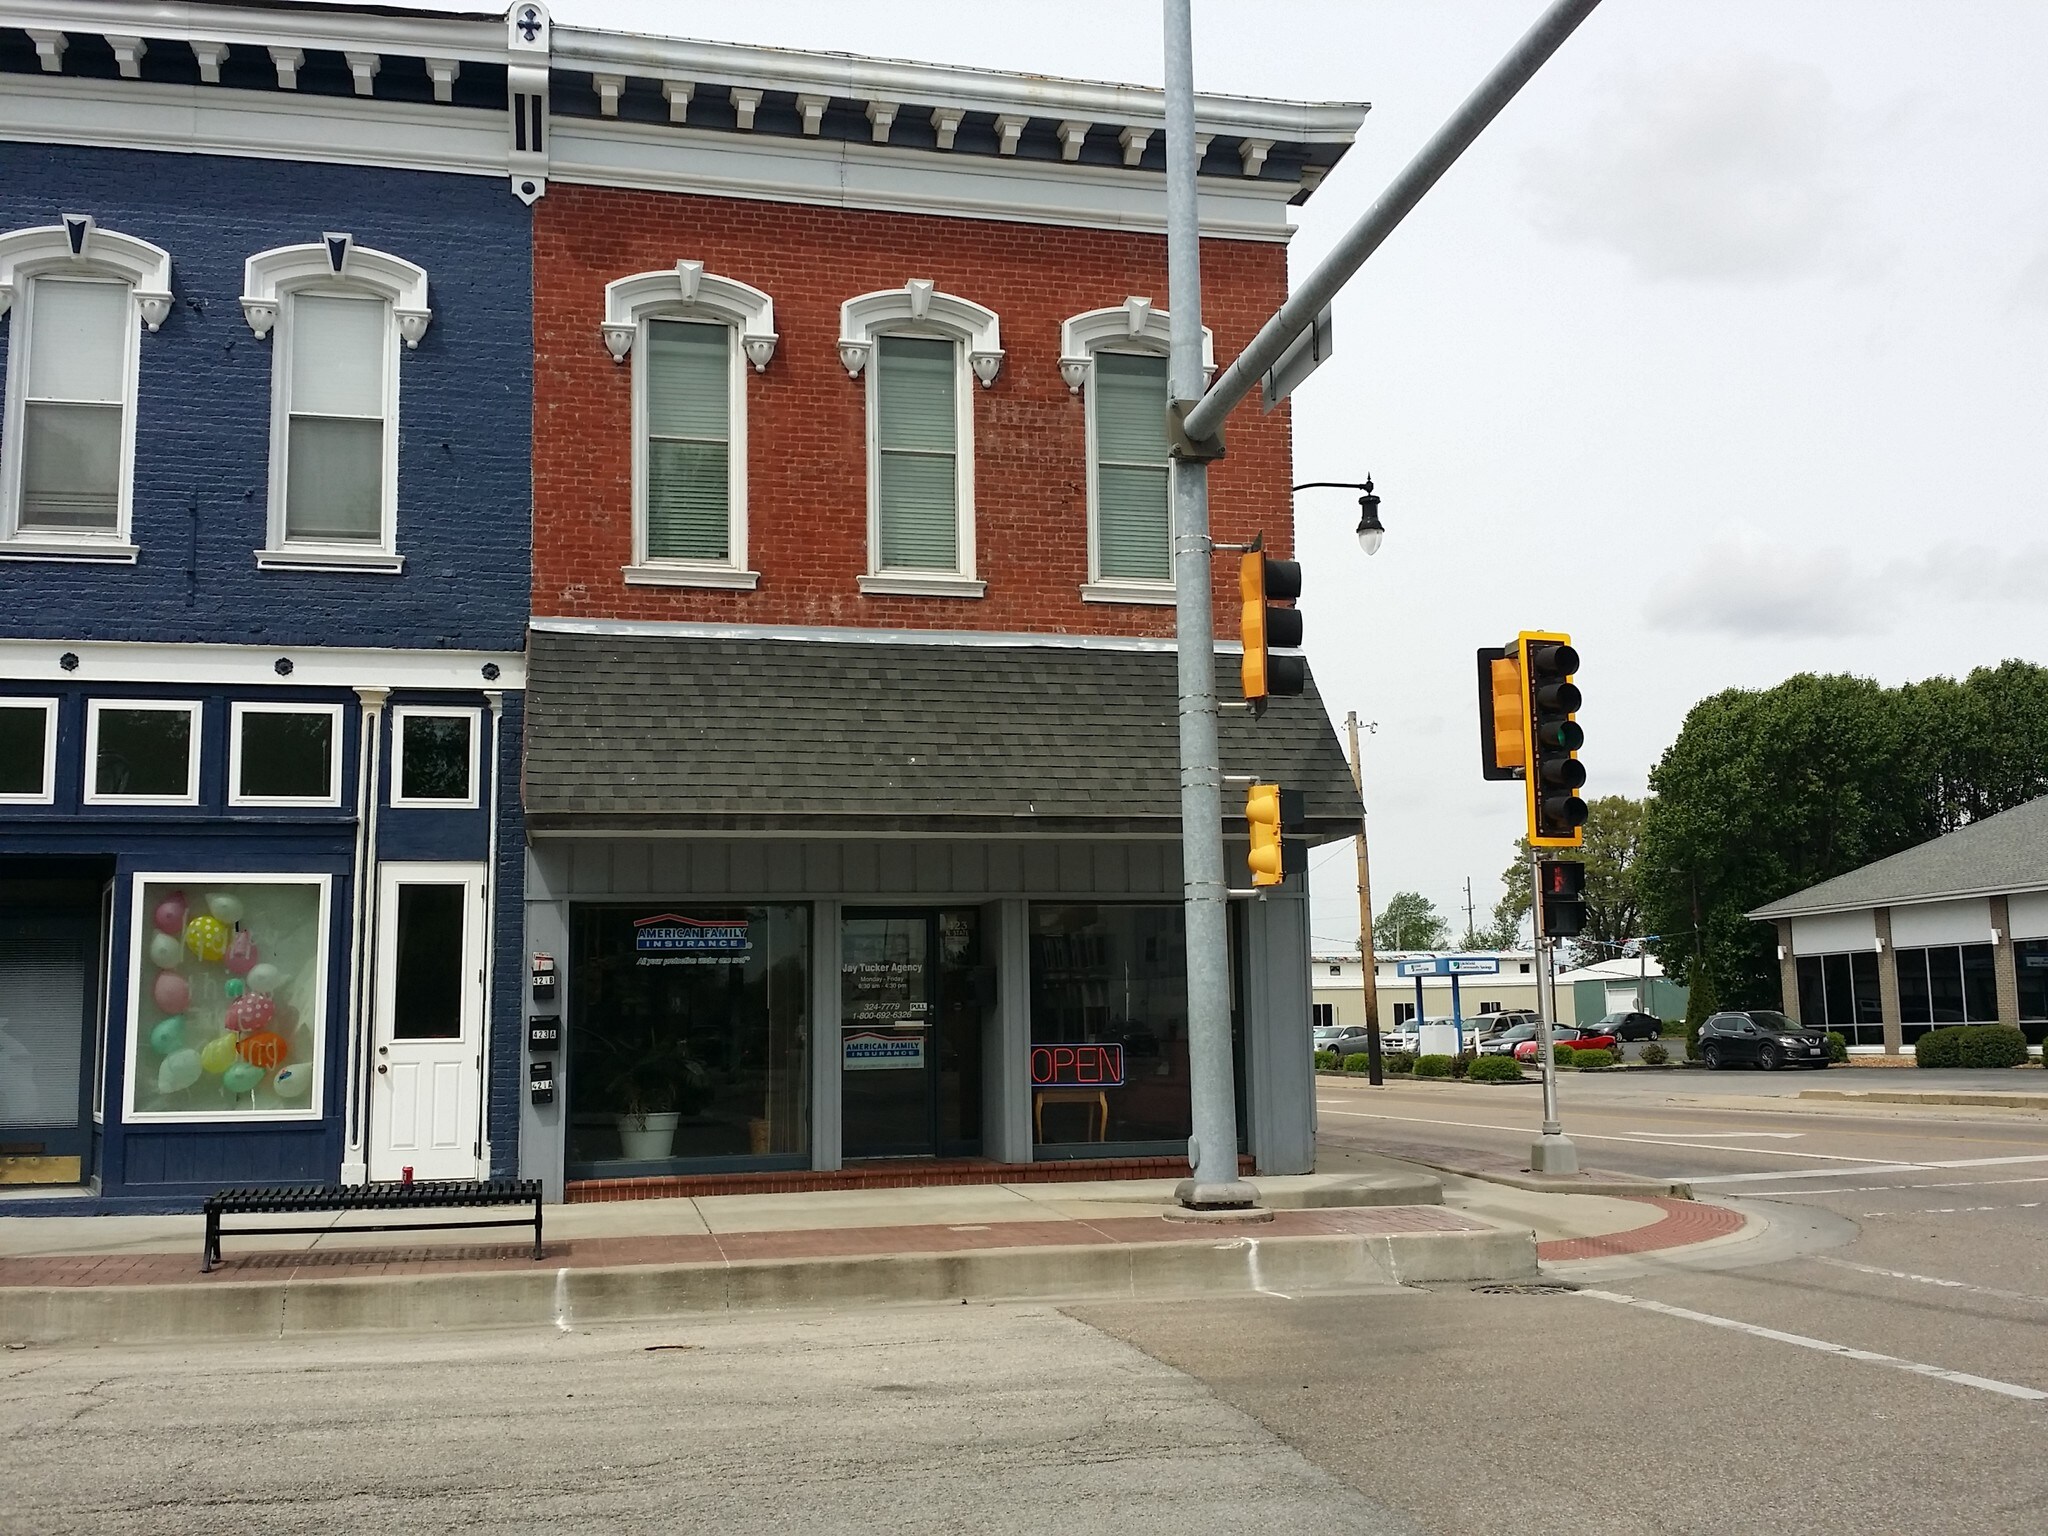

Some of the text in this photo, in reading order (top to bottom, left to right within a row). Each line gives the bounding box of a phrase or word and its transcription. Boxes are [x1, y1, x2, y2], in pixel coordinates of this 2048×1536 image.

[638, 927, 747, 939] AMERICAN FAMILY
[842, 963, 923, 974] Jay Tucker Agency
[887, 975, 904, 983] Friday
[864, 1002, 900, 1010] 324-7779
[853, 1011, 912, 1020] 1-800-692-6326
[1031, 1046, 1120, 1082] OPEN
